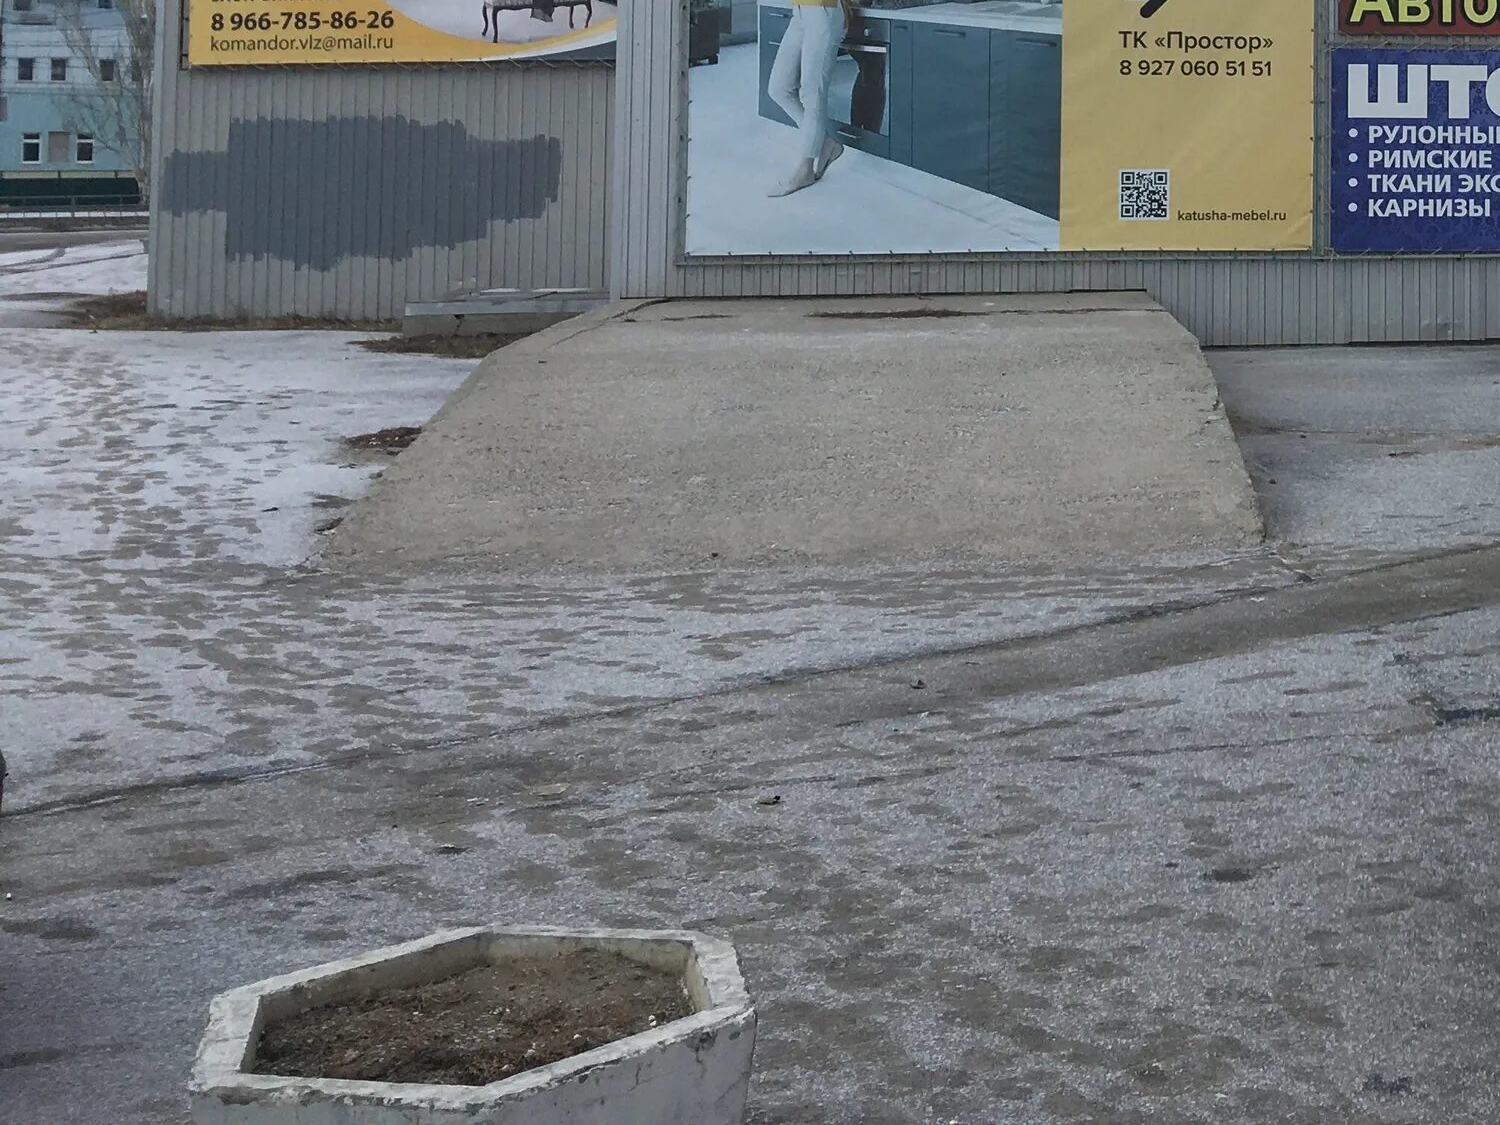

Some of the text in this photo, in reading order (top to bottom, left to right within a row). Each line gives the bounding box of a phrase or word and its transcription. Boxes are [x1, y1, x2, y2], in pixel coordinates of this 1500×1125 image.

[211, 11, 395, 31] 8 966-785-86-26
[210, 34, 394, 52] komandor.vlz@mail.ru
[1118, 31, 1274, 53] ТК «Простор»
[1119, 59, 1272, 77] 8 927 060 51 51
[1368, 150, 1492, 168] РИМСКИЕ
[1368, 174, 1451, 193] ТКАНИ
[1177, 210, 1287, 221] katusha-mebel.ru
[1368, 198, 1491, 217] КАРНИЗЫ
